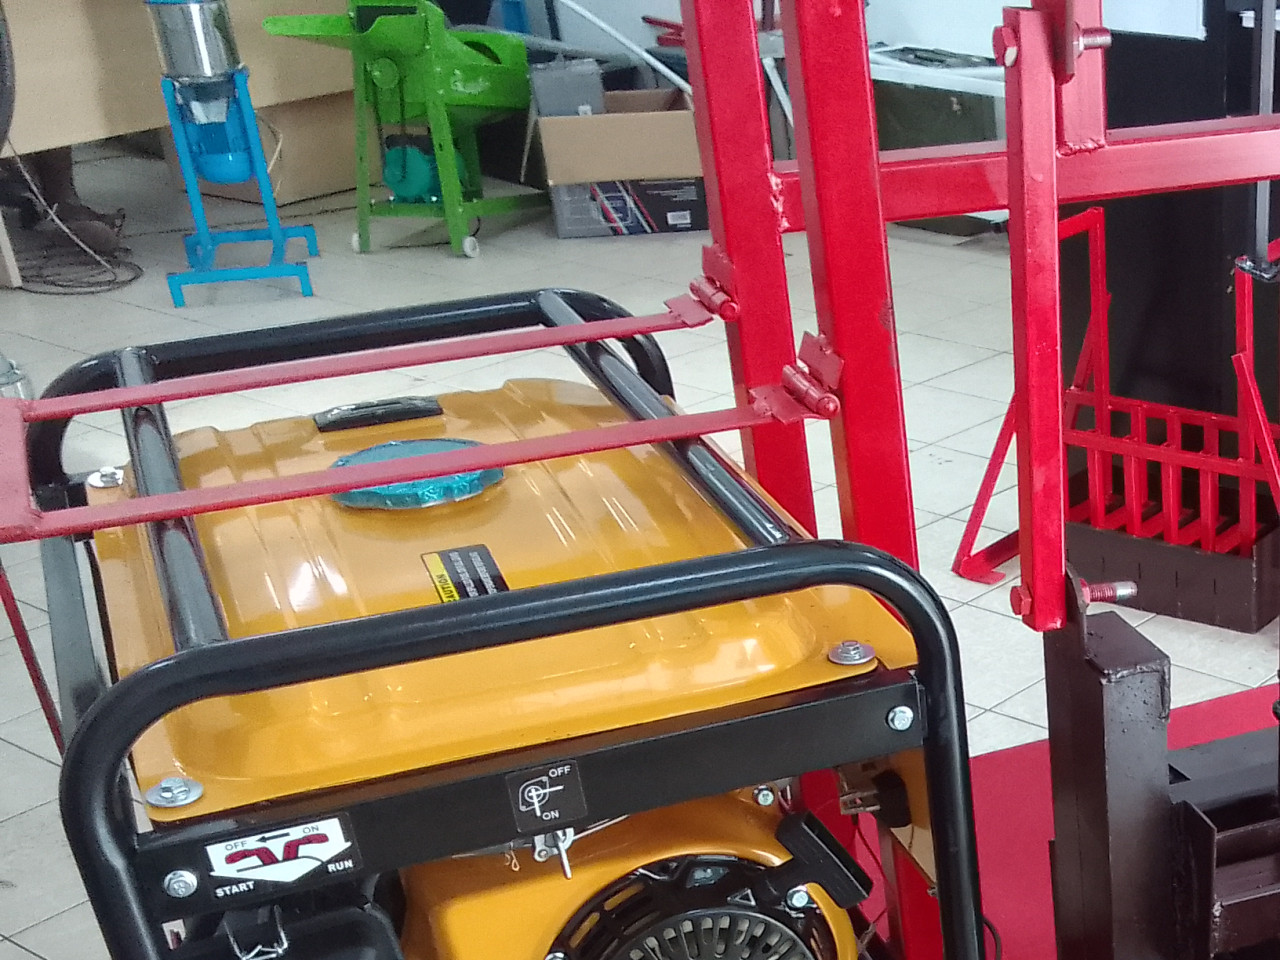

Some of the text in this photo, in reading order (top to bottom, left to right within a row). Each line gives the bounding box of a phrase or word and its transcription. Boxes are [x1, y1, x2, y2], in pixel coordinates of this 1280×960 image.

[436, 574, 458, 602] AUTION
[548, 765, 571, 778] OFF
[542, 810, 560, 820] ON
[302, 825, 320, 834] ON
[225, 841, 248, 851] OFF
[327, 860, 353, 872] RUN
[215, 881, 255, 897] START
